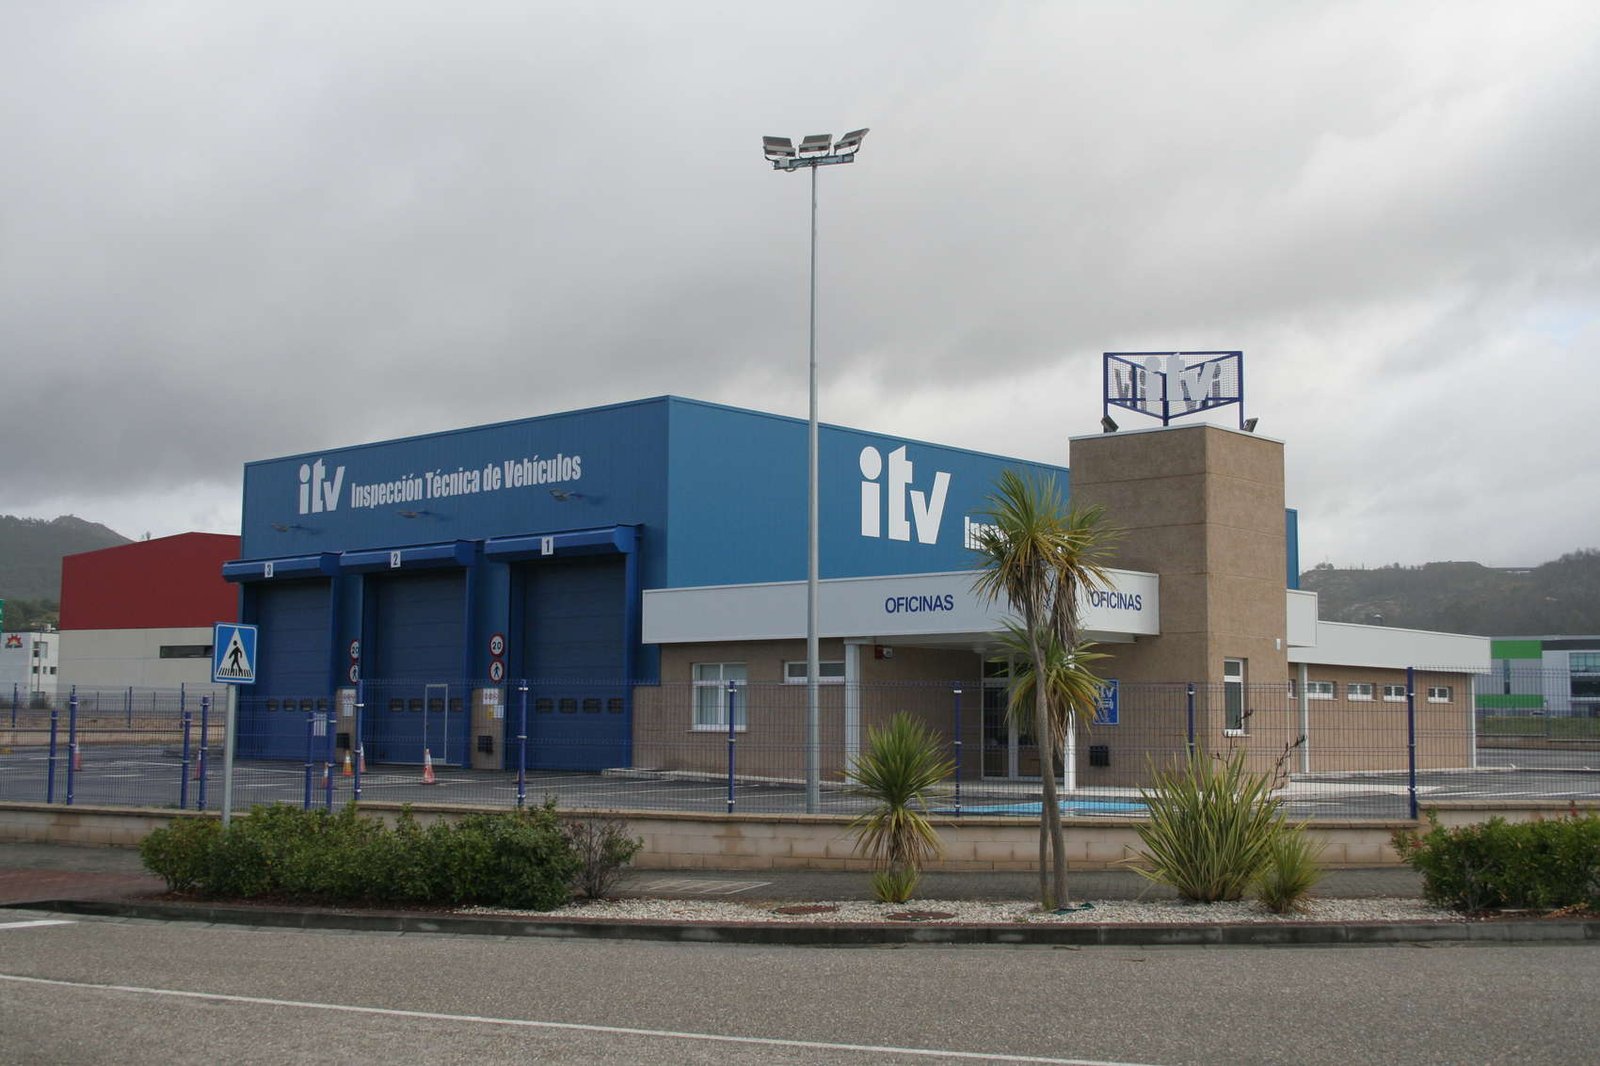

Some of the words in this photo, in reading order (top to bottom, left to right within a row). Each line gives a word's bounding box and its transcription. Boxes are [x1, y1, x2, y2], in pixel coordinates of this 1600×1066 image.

[299, 458, 345, 515] itv
[351, 473, 423, 509] Inspección
[425, 467, 480, 499] Técnica
[483, 463, 501, 492] de
[504, 453, 582, 489] Vehículos
[859, 445, 951, 544] itv
[885, 594, 954, 613] OFICINAS
[1091, 590, 1142, 611] OFICINAS
[492, 641, 502, 650] 20
